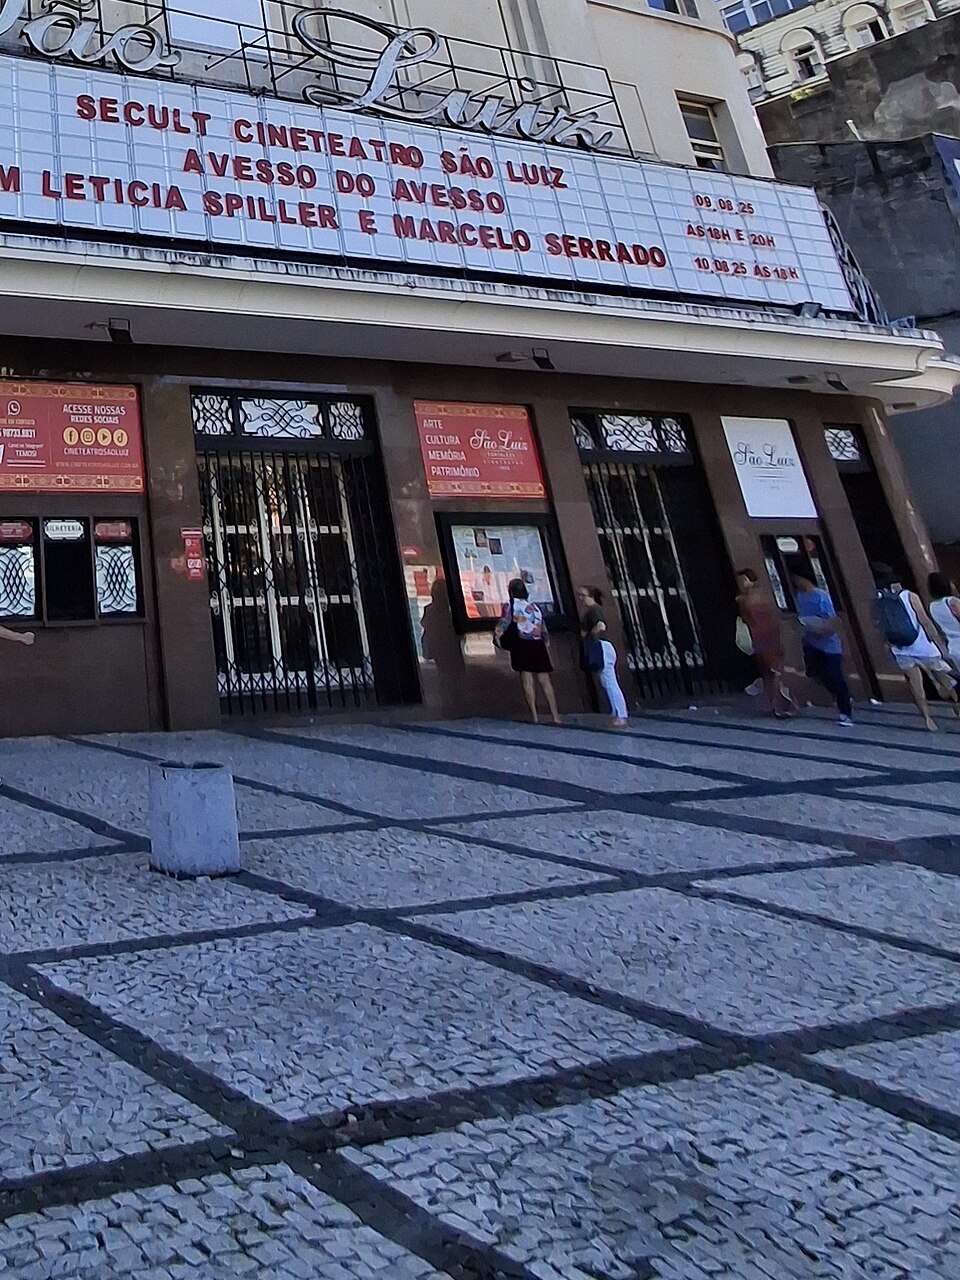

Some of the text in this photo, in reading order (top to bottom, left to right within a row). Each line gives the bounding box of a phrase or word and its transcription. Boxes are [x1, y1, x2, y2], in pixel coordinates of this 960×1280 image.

[291, 7, 614, 150] Luiz
[77, 94, 568, 189] SECULT CINETEATRO SÃO LUIZ
[183, 148, 505, 214] AVESSO DO AVESSO
[695, 194, 755, 215] 09.08.25
[42, 170, 188, 211] LETICIA
[203, 190, 340, 230] SPILLER
[358, 209, 378, 234] E
[393, 214, 531, 252] MARCELO
[544, 232, 667, 268] SERRADO
[735, 228, 745, 241] E
[750, 233, 776, 248] 20H
[694, 257, 748, 276] 10.08.25
[63, 404, 126, 415] ACESSE NOSSAS
[70, 415, 119, 424] REDES SOCIAIS
[423, 419, 443, 429] ARTE
[425, 434, 461, 445] CULTURA
[469, 428, 529, 451] São Luiz
[428, 448, 467, 461] MEMÓRIA
[733, 442, 762, 466] São
[431, 464, 480, 477] PATRIMÔNIO
